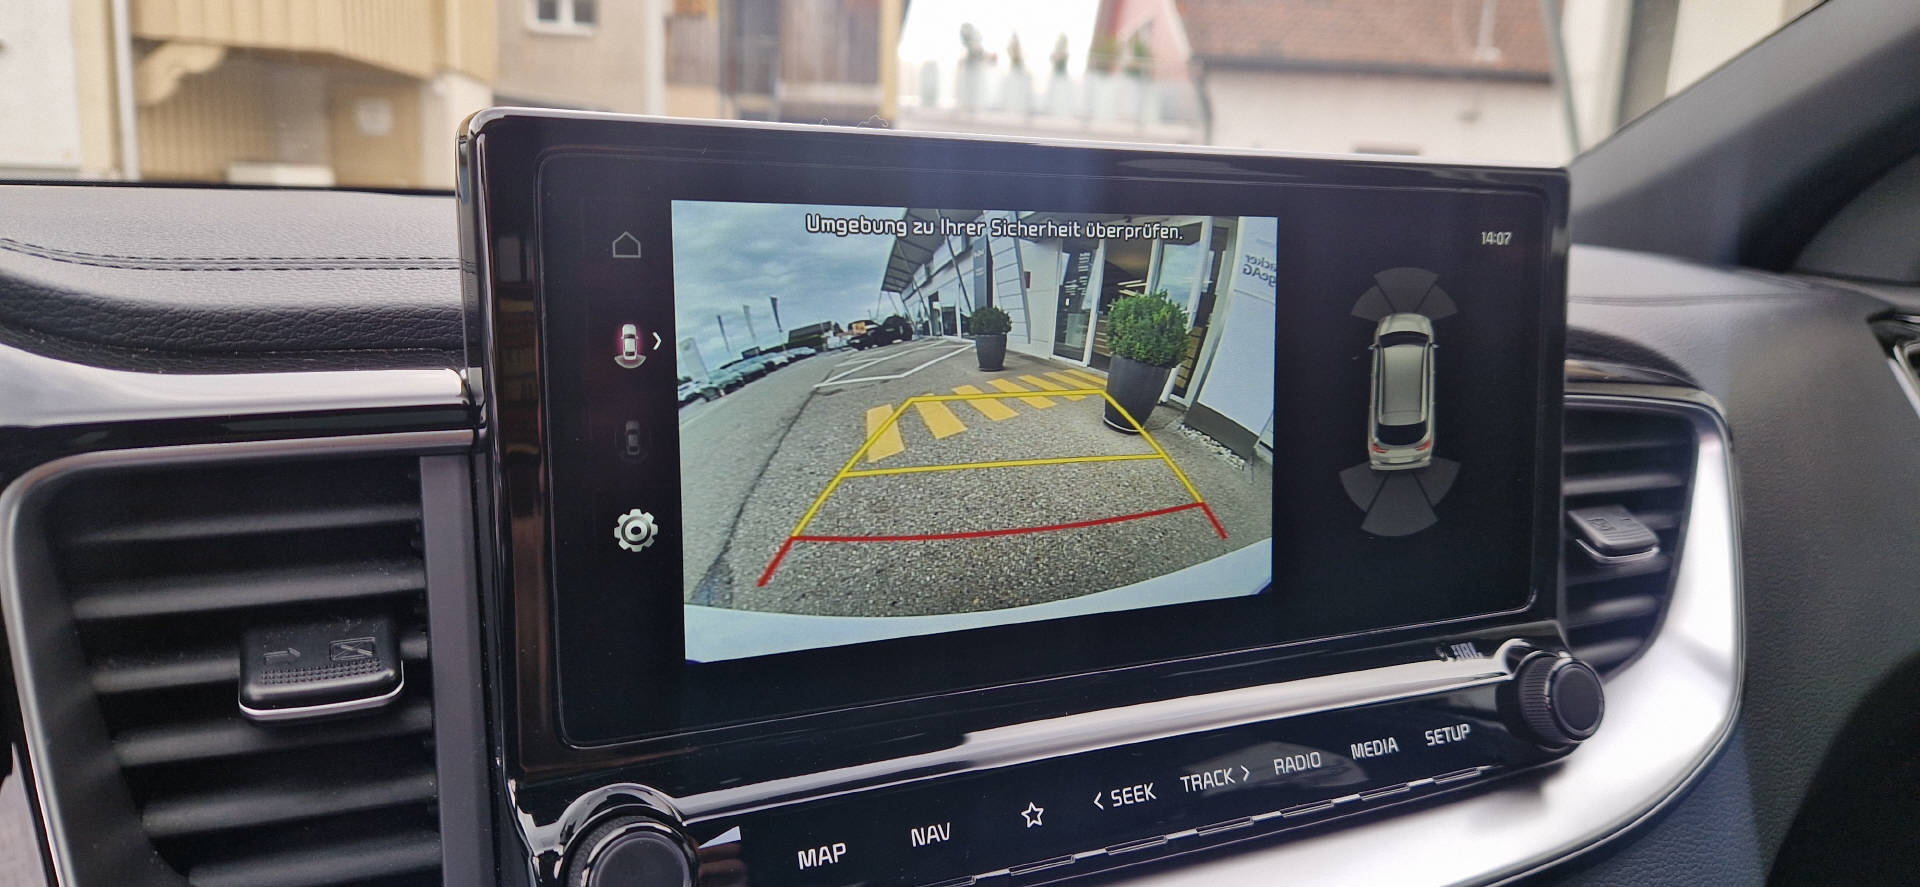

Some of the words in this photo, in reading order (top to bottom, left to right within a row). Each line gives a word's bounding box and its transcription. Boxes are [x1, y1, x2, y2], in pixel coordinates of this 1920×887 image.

[805, 213, 908, 237] Umgebung
[912, 221, 935, 235] zu
[940, 217, 987, 236] Ihrer
[991, 218, 1081, 238] Sicherheit
[1085, 222, 1185, 241] überprüfen.
[1481, 231, 1512, 246] 14:07
[1424, 723, 1471, 746] SETUP
[1350, 736, 1400, 760] MEDIA
[1273, 751, 1322, 776] RADIO
[1110, 782, 1157, 808] SEEK
[1179, 767, 1236, 793] TRACK
[910, 822, 951, 848] NAV
[797, 842, 847, 871] MAP
